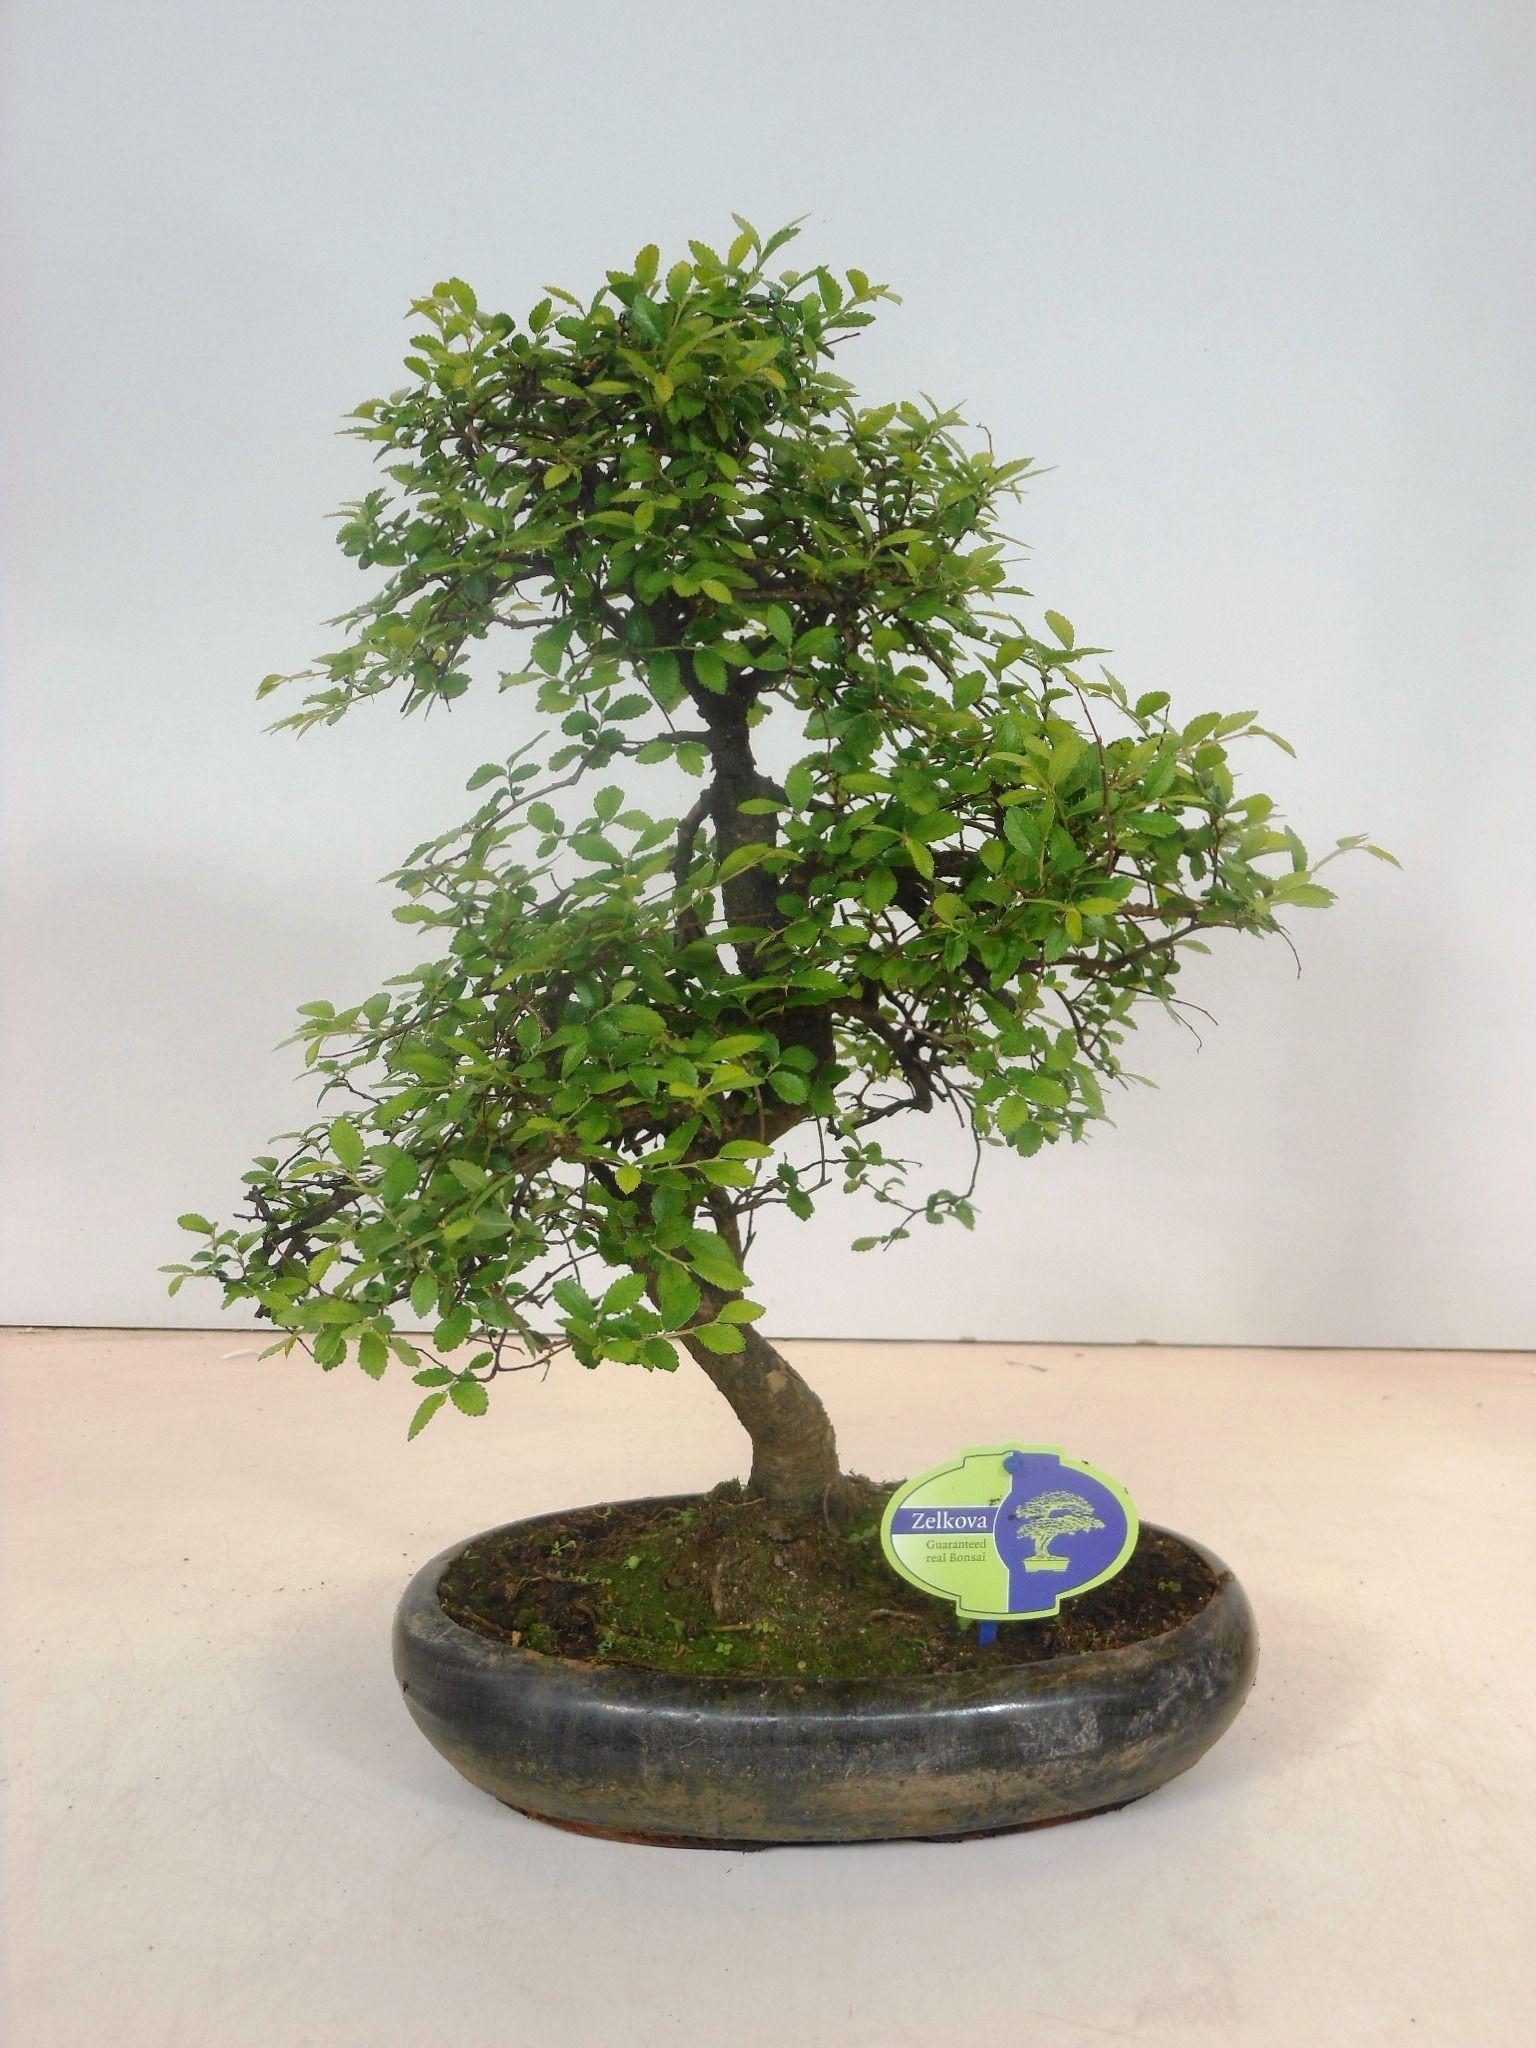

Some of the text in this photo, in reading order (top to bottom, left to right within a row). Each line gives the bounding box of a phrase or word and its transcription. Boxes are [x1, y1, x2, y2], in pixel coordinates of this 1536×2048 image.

[911, 1511, 987, 1529] Zelkova
[926, 1539, 987, 1549] Guaranteed
[926, 1552, 986, 1563] real Bonsai
